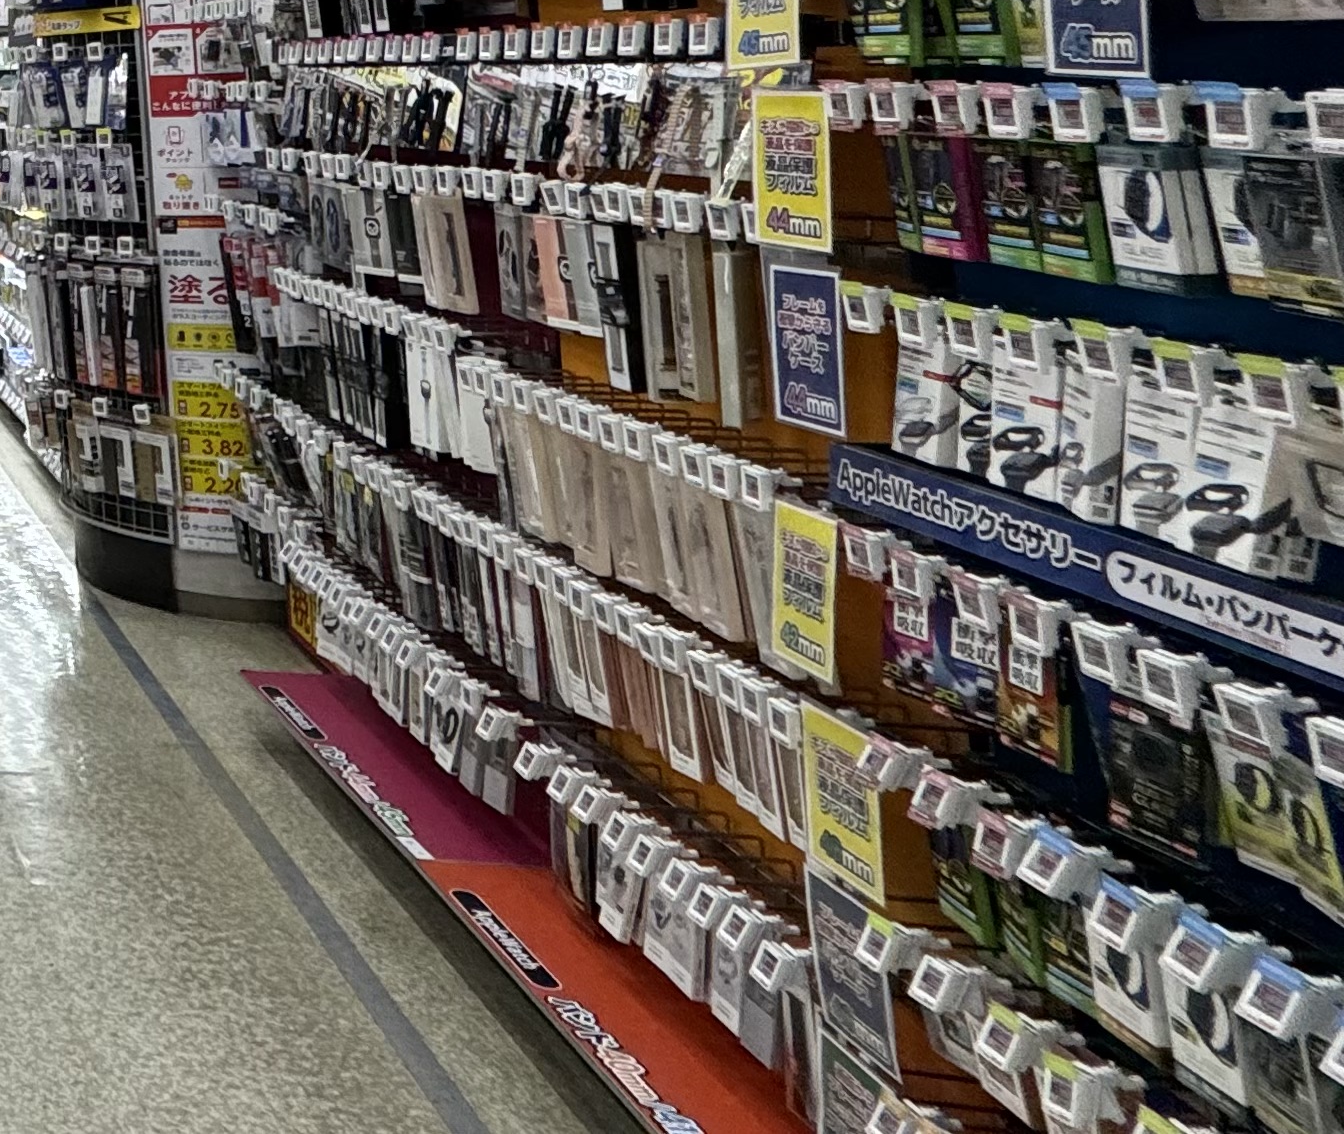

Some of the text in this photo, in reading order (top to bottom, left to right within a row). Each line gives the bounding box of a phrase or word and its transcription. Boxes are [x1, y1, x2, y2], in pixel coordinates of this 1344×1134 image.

[738, 30, 789, 56] 45mm
[766, 207, 822, 237] 44mm
[168, 274, 230, 305] 塗る
[784, 382, 837, 423] 44mm
[836, 460, 1102, 572] AppleWatchアクセサリー
